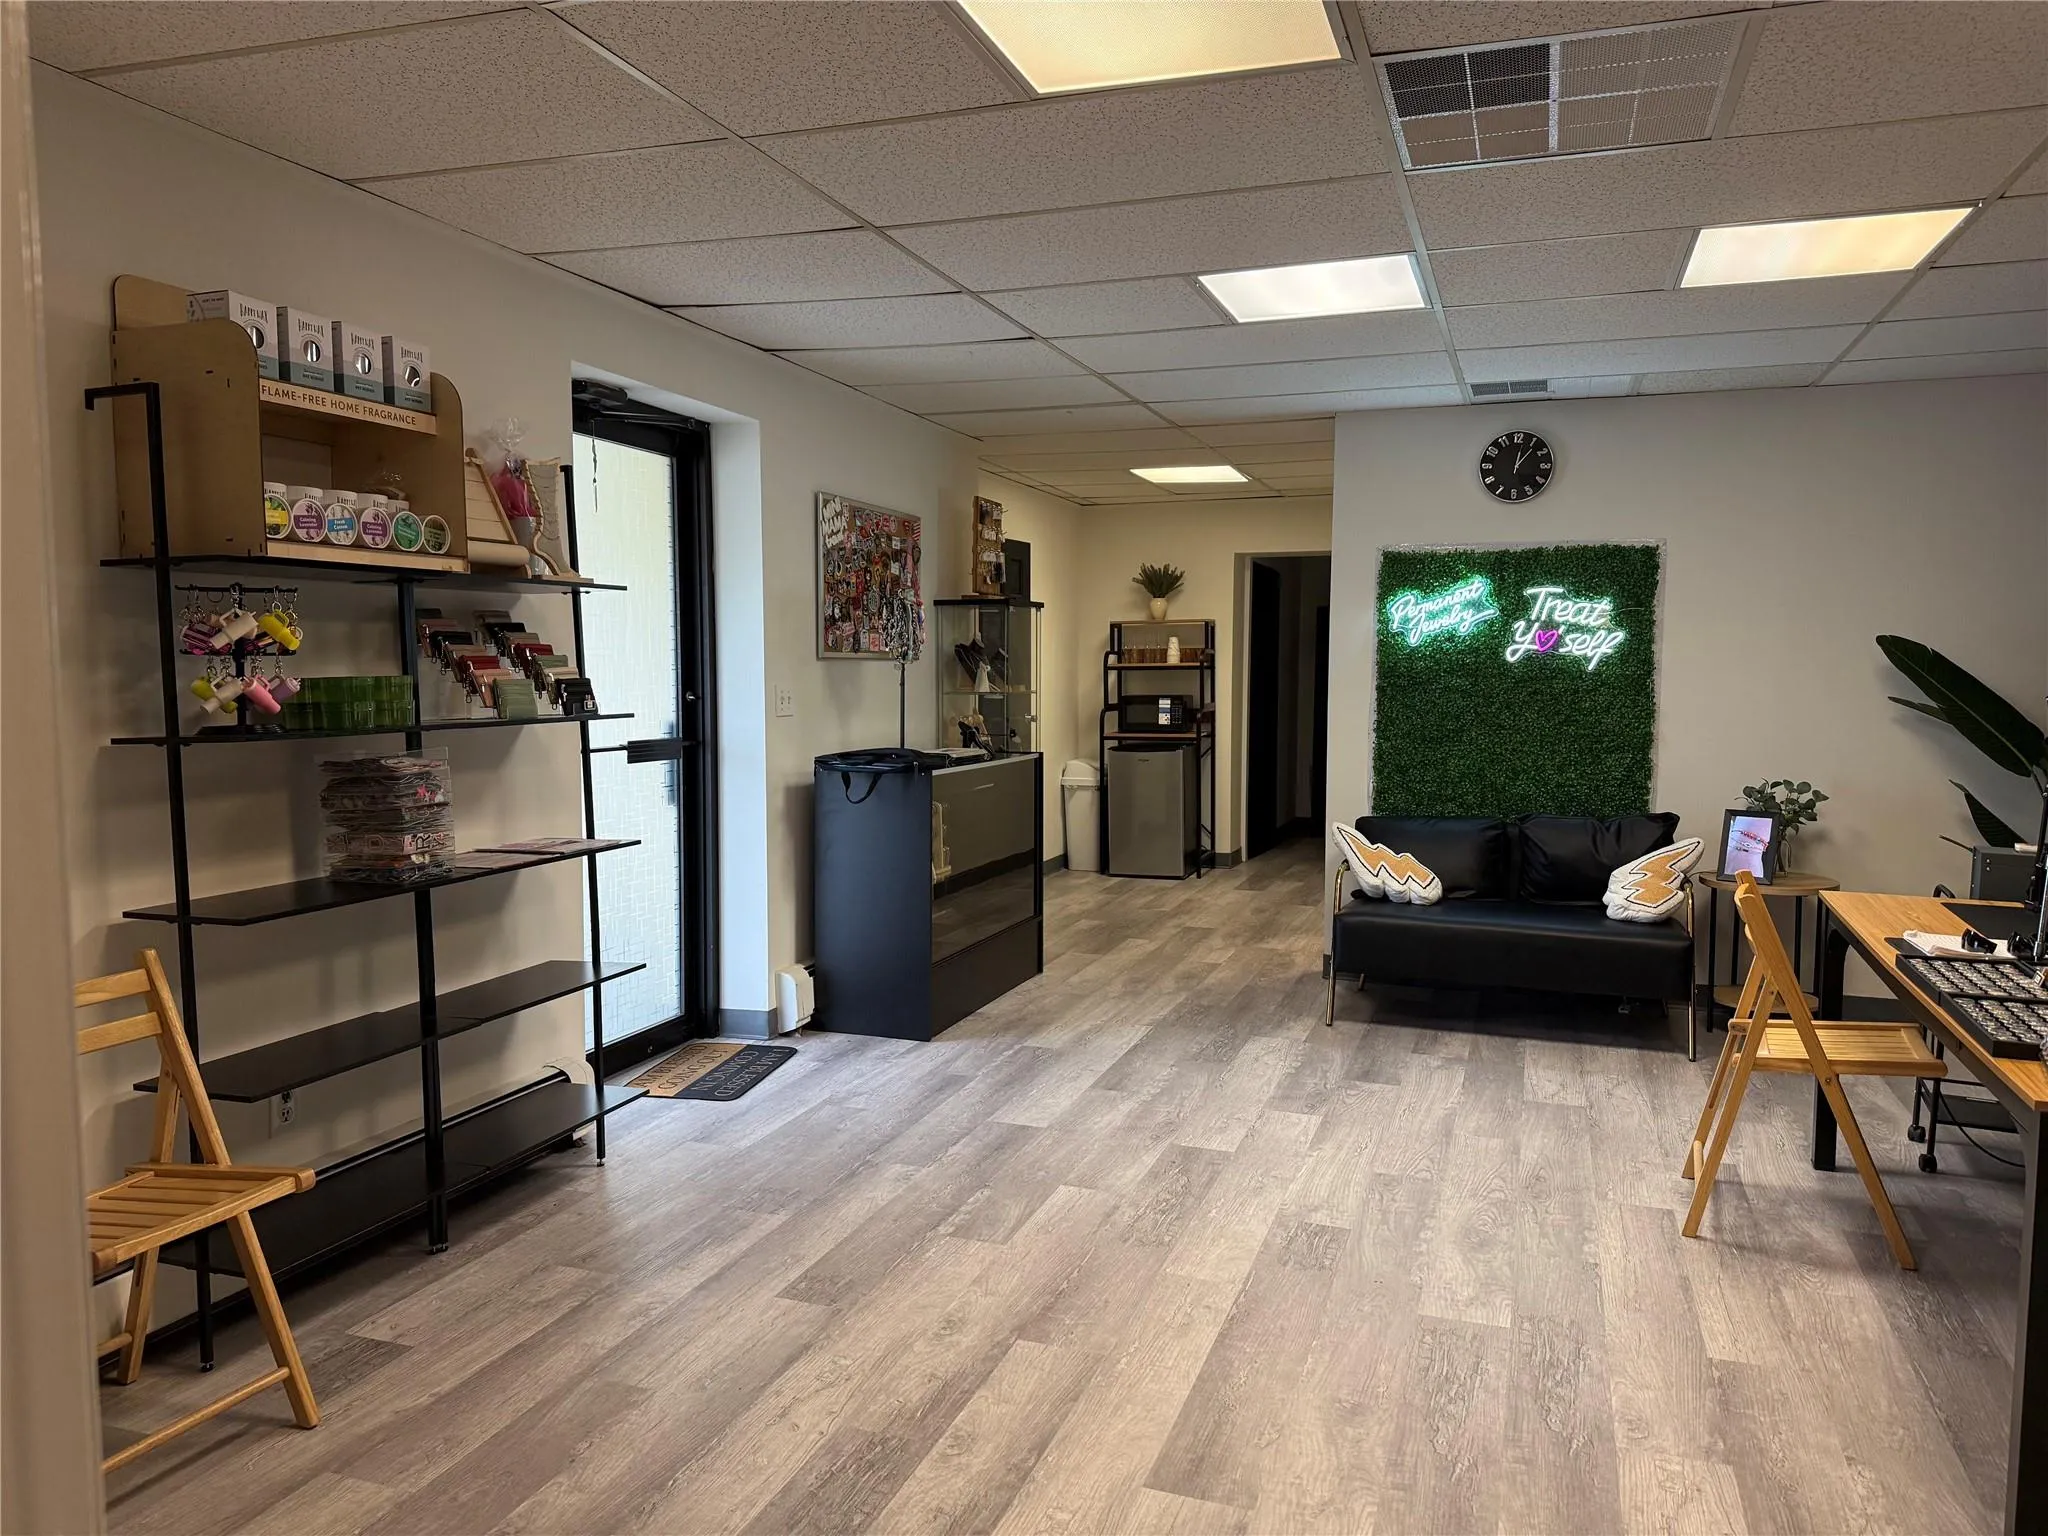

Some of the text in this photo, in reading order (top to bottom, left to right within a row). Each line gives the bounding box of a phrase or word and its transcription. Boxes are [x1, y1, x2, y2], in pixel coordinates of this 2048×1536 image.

[261, 384, 417, 426] FLAME-FREE HOME FRAGRANCE
[1498, 436, 1510, 448] 11
[1513, 432, 1524, 444] 12
[1529, 437, 1537, 447] 1
[1486, 446, 1499, 458] 10
[1536, 447, 1548, 457] 2
[1481, 462, 1493, 470] 9
[1540, 462, 1551, 470] 3
[1484, 475, 1495, 484] 8
[1535, 475, 1545, 484] 4
[1495, 484, 1505, 495] 7
[1510, 488, 1518, 499] 6
[1524, 484, 1534, 496] 5
[1391, 579, 1485, 630] Permanent
[1526, 587, 1611, 627] Treat
[1409, 604, 1496, 644] Jewelry
[658, 1049, 729, 1090] GOING OUT
[706, 1050, 760, 1082] COMING
[714, 1064, 767, 1097] BLESSED
